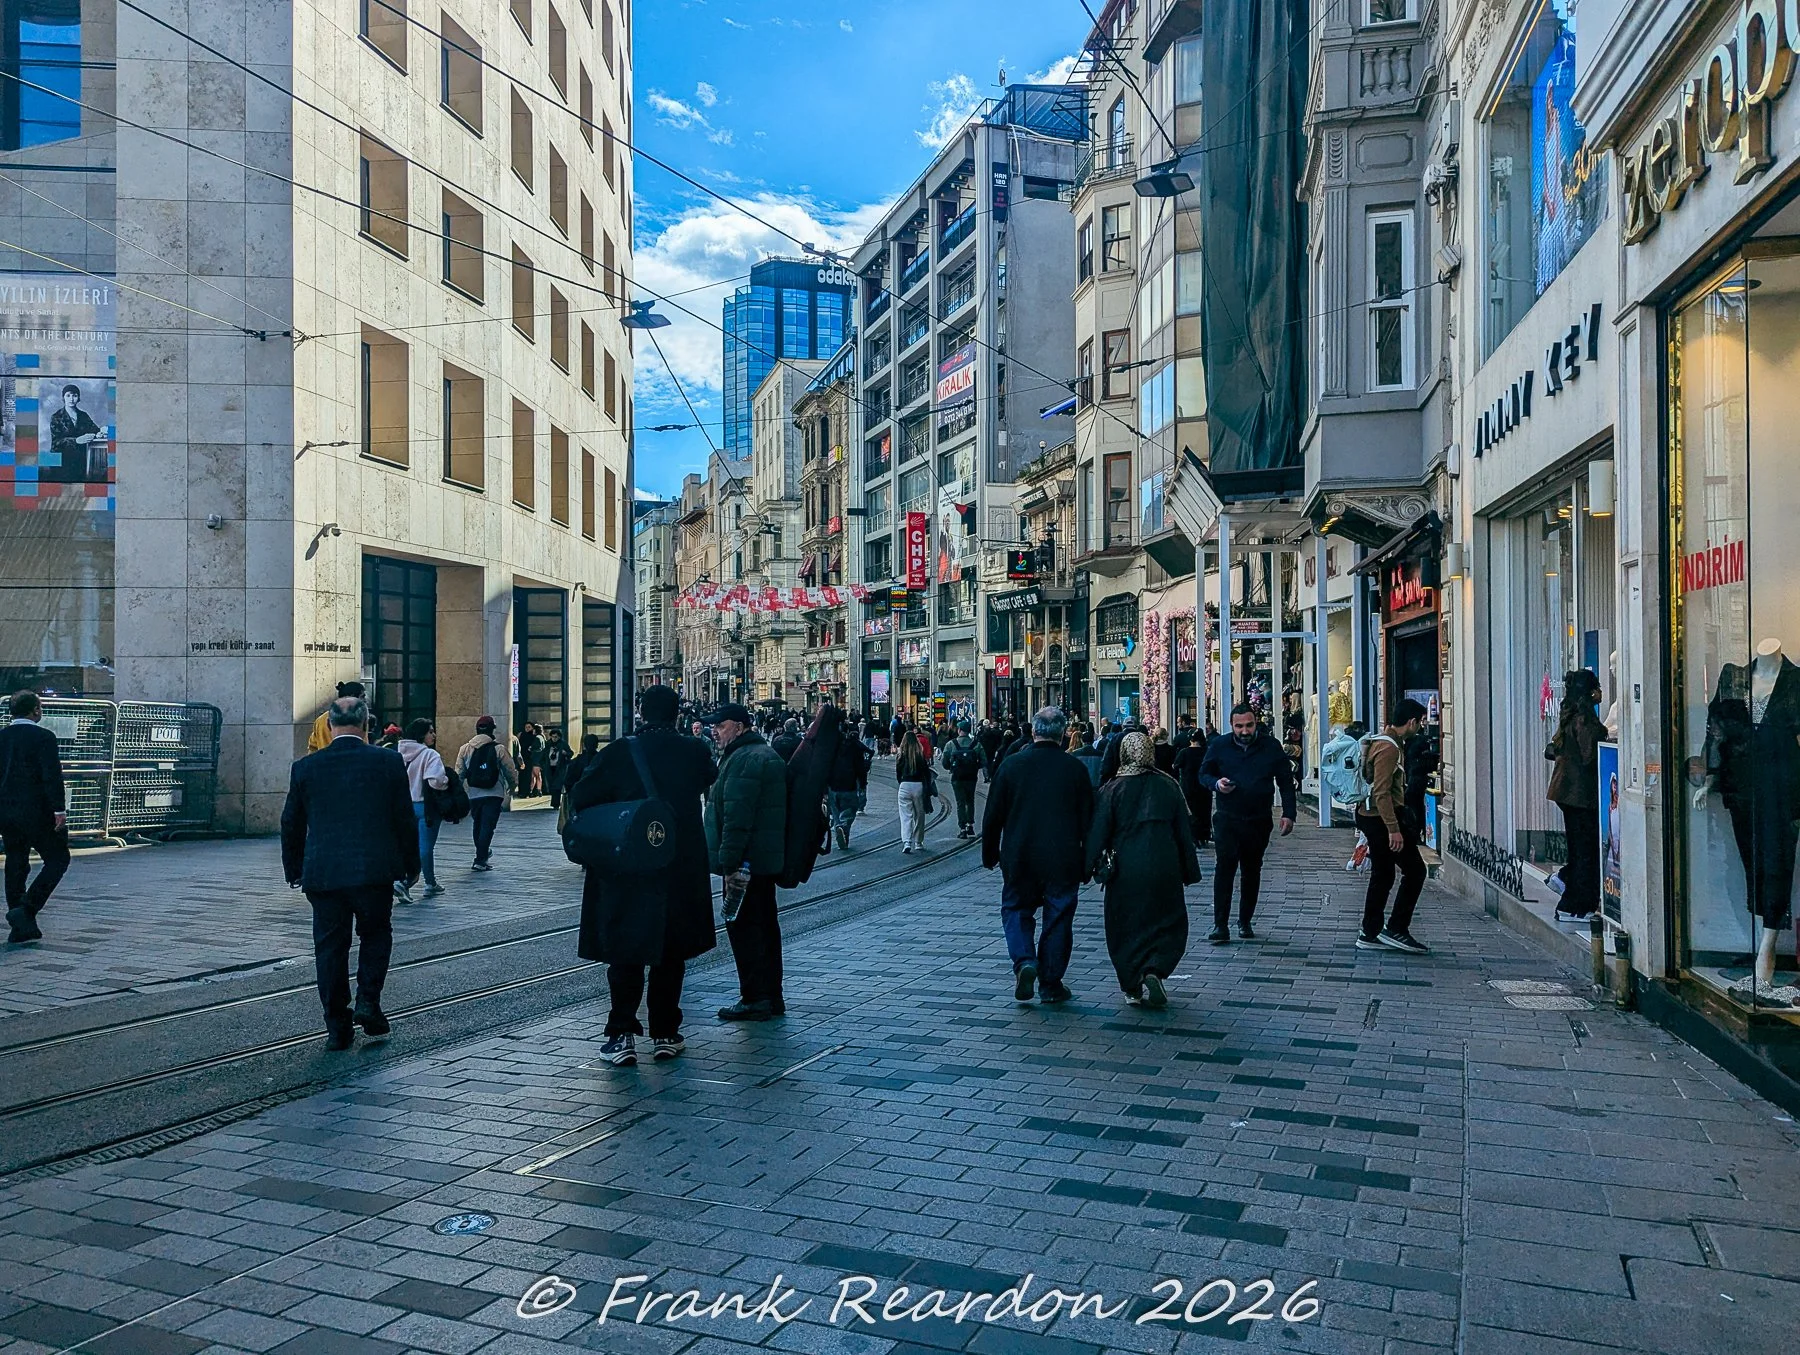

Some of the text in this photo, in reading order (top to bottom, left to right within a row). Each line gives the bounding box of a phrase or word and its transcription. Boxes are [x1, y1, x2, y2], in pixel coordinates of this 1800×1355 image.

[994, 172, 1007, 180] HAN
[54, 284, 109, 306] İZLERİ
[24, 329, 37, 340] ON
[42, 330, 60, 341] THE
[64, 330, 110, 342] CENTURY
[1473, 303, 1602, 458] JIMMY KEY
[911, 530, 923, 571] CHP
[191, 640, 275, 652] yapı kredi kültür sanat
[1106, 647, 1126, 659] Telekom
